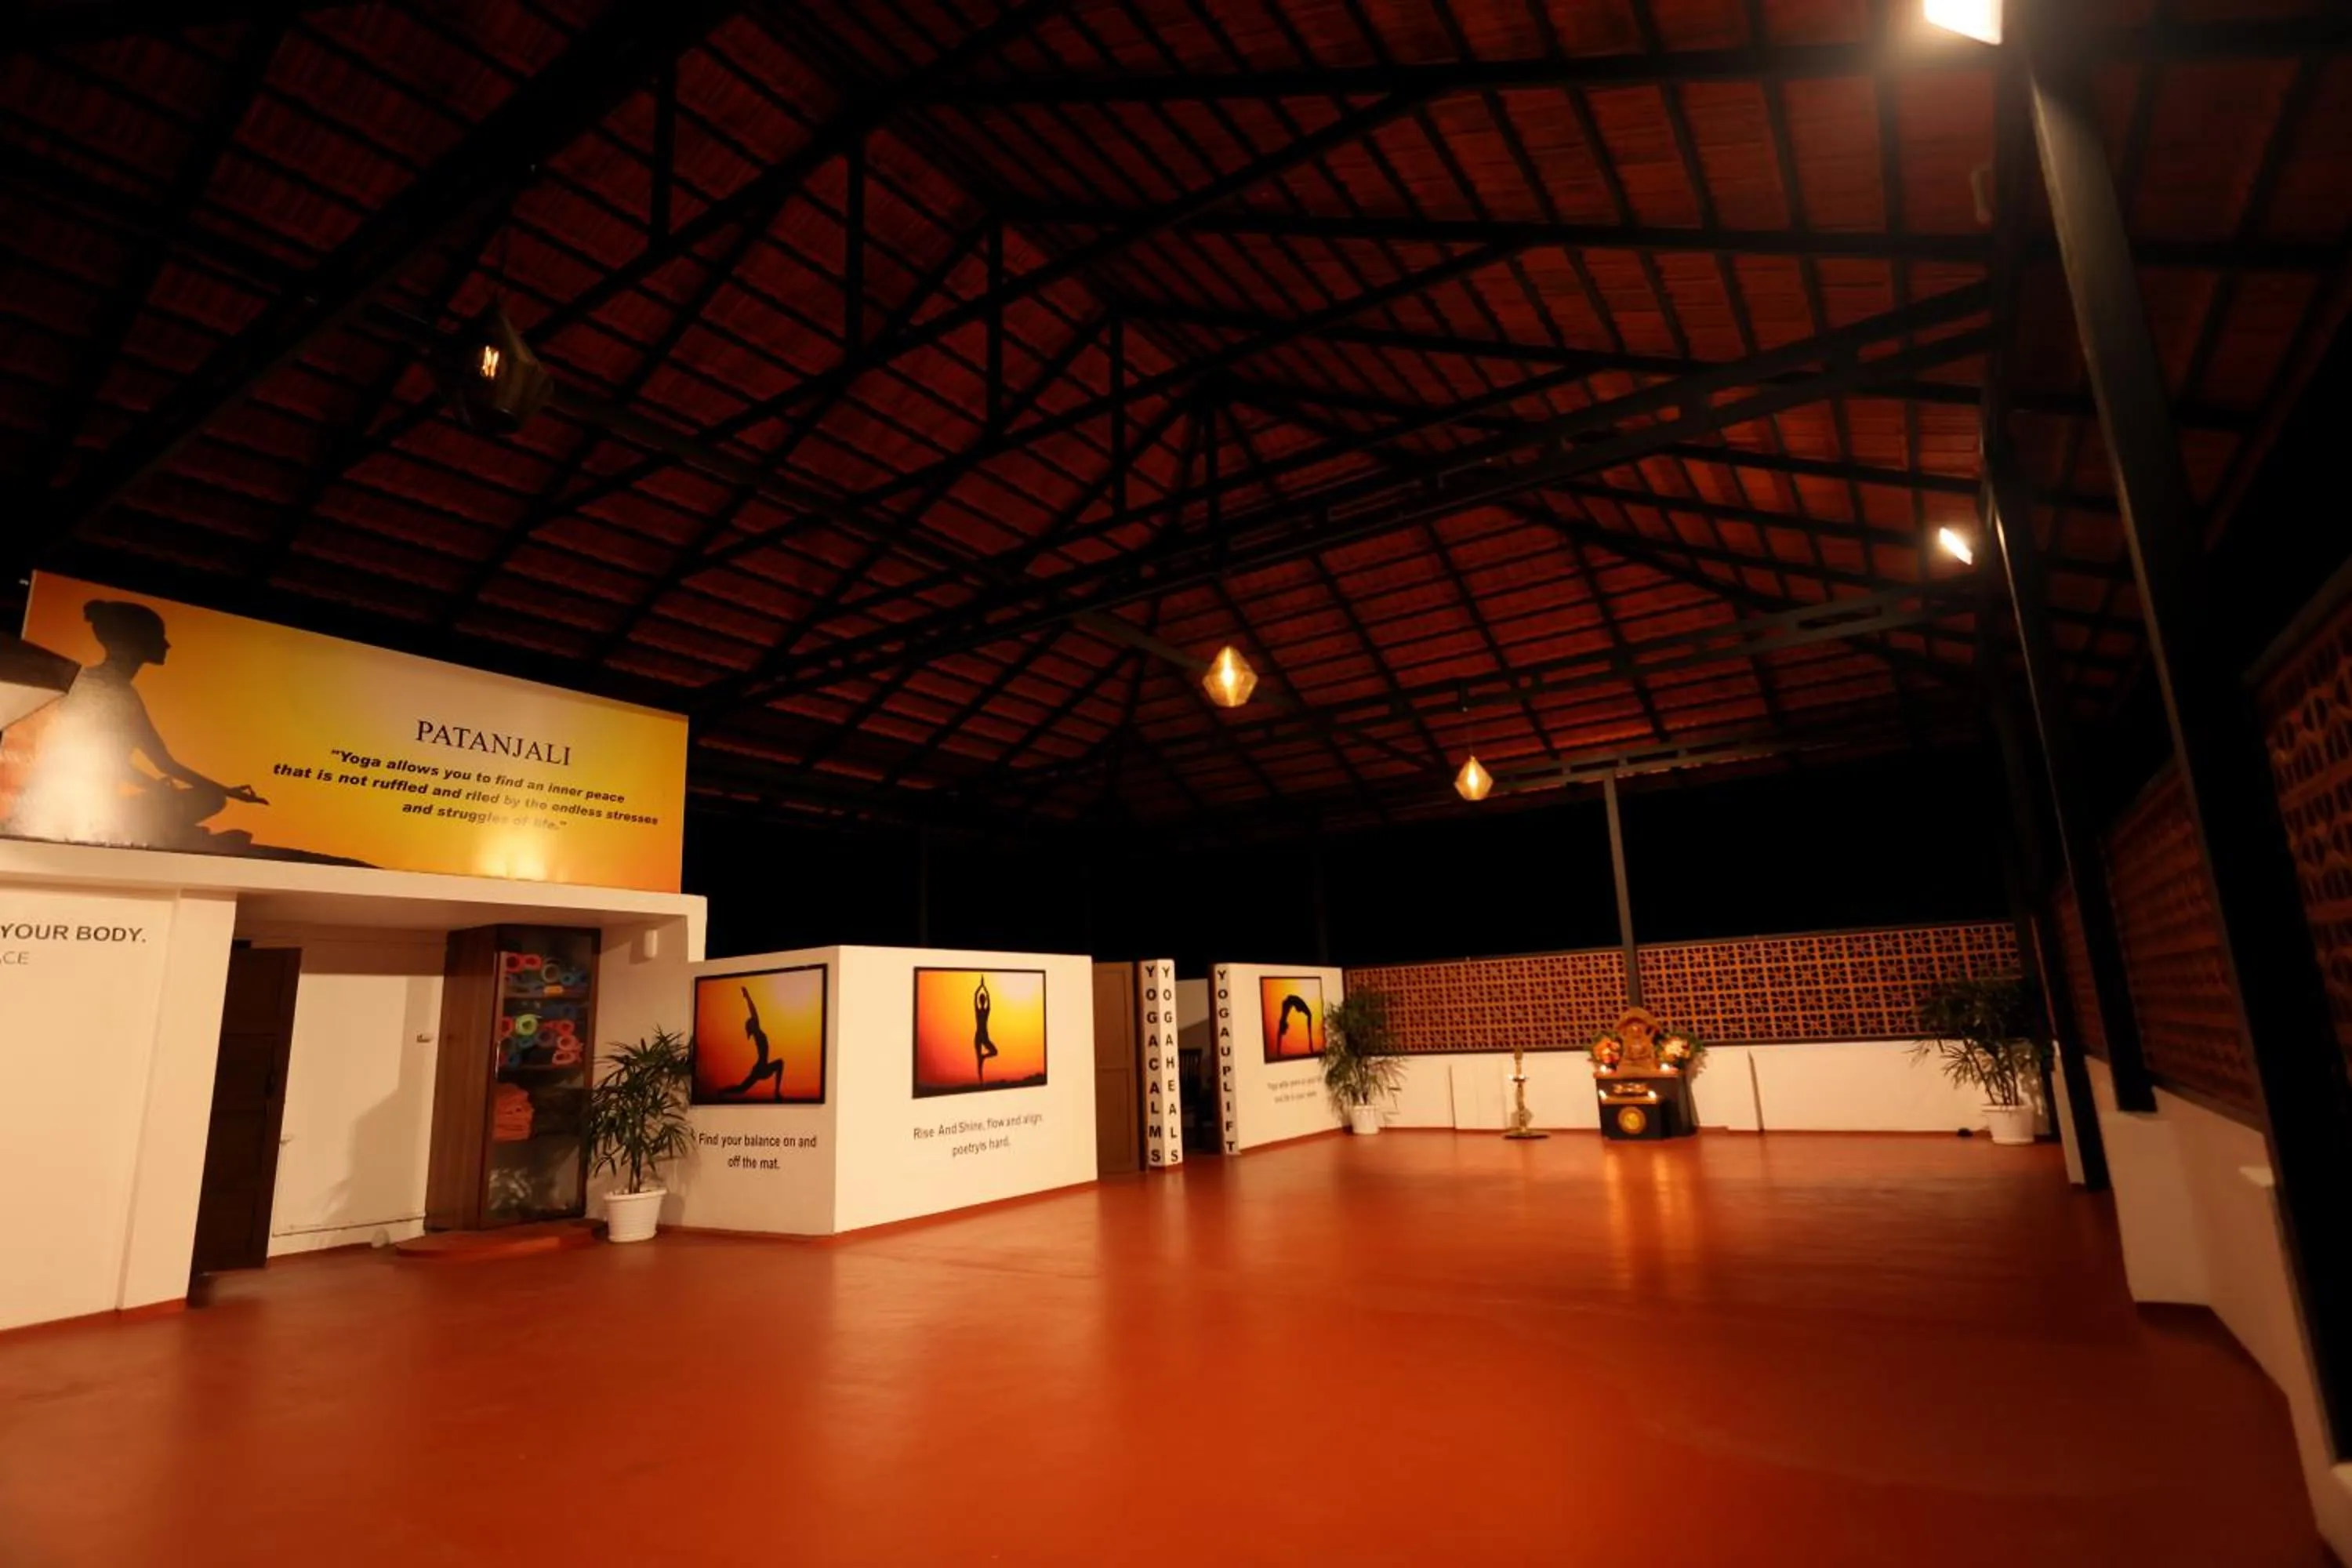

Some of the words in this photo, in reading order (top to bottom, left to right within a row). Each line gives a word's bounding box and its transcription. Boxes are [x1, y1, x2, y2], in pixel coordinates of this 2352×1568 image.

[416, 720, 572, 766] PATANJALI
[386, 760, 439, 776] allows
[443, 769, 471, 779] you
[476, 772, 492, 783] to
[495, 775, 524, 788] find
[527, 782, 544, 791] an
[547, 782, 583, 797] inner
[586, 790, 625, 803] peace
[273, 764, 312, 779] that
[317, 769, 332, 782] is
[338, 775, 368, 786] not
[372, 778, 429, 794] ruffled
[432, 787, 462, 799] and
[465, 790, 500, 804] riled
[503, 795, 521, 808] by
[525, 797, 548, 811] the
[551, 803, 603, 818] endless
[605, 810, 659, 826] stresses
[402, 804, 433, 815] and
[437, 808, 509, 824] struggles
[514, 815, 529, 826] of
[0, 924, 68, 940] YOUR
[76, 926, 147, 943] BODY.
[0, 950, 30, 965] CE
[913, 1127, 935, 1139] Rise
[938, 1123, 957, 1136] And
[986, 1117, 1005, 1129] flow
[1006, 1116, 1022, 1127] and
[699, 1133, 719, 1145] Find
[721, 1135, 742, 1148] your
[744, 1134, 781, 1147] balance
[783, 1136, 796, 1147] on
[797, 1135, 817, 1147] and
[727, 1156, 741, 1167] off
[742, 1156, 757, 1168] the
[760, 1157, 781, 1169] mat.
